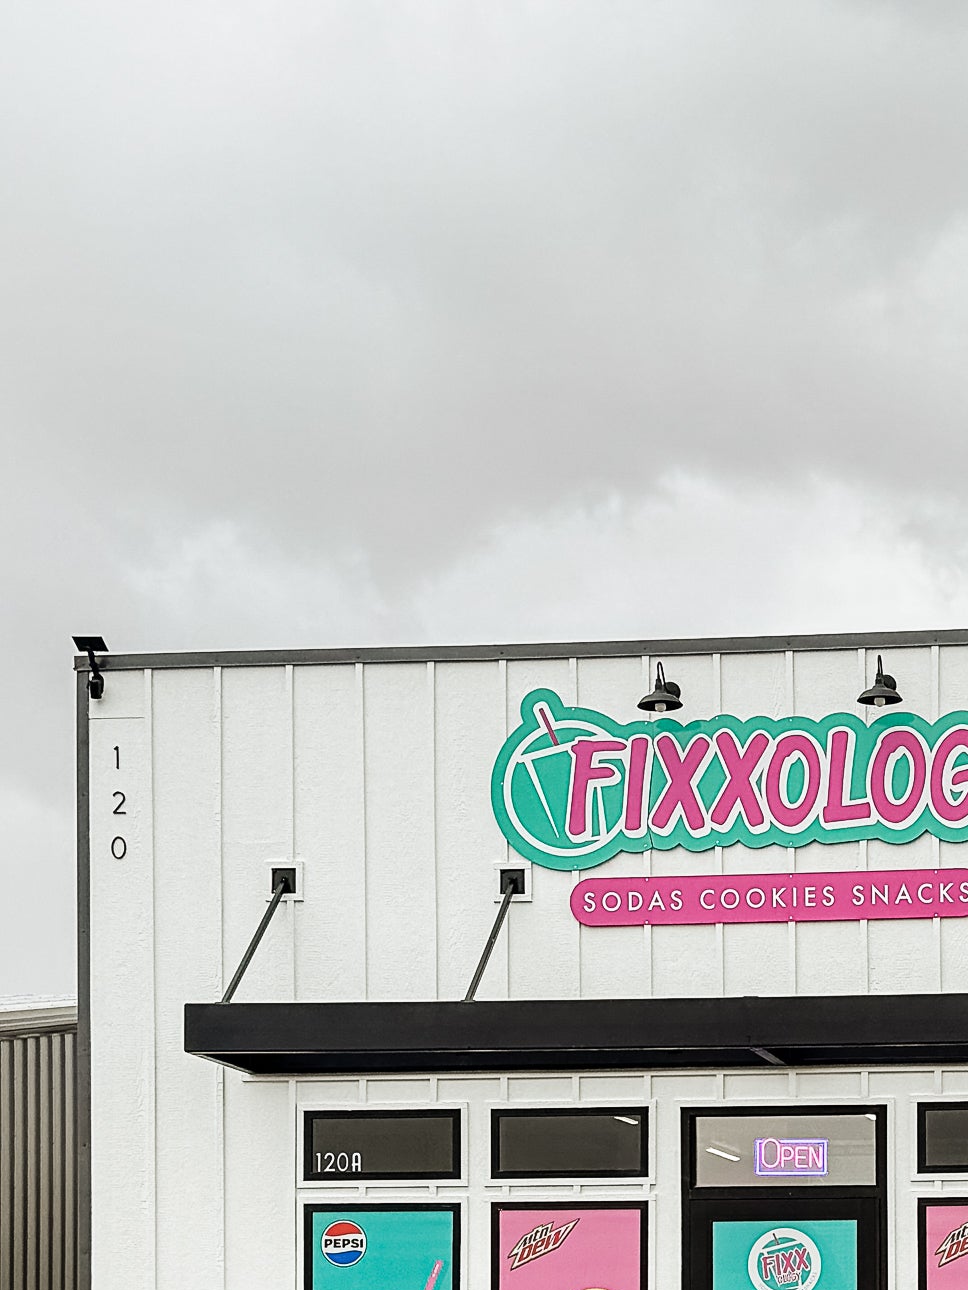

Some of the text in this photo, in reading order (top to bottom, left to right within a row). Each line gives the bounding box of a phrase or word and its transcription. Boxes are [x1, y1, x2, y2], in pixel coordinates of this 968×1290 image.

[583, 890, 683, 913] SODAS
[699, 886, 835, 910] COOKIES
[761, 1138, 824, 1168] OPEN
[324, 1238, 364, 1249] PEPSI
[762, 1248, 809, 1279] FIXX
